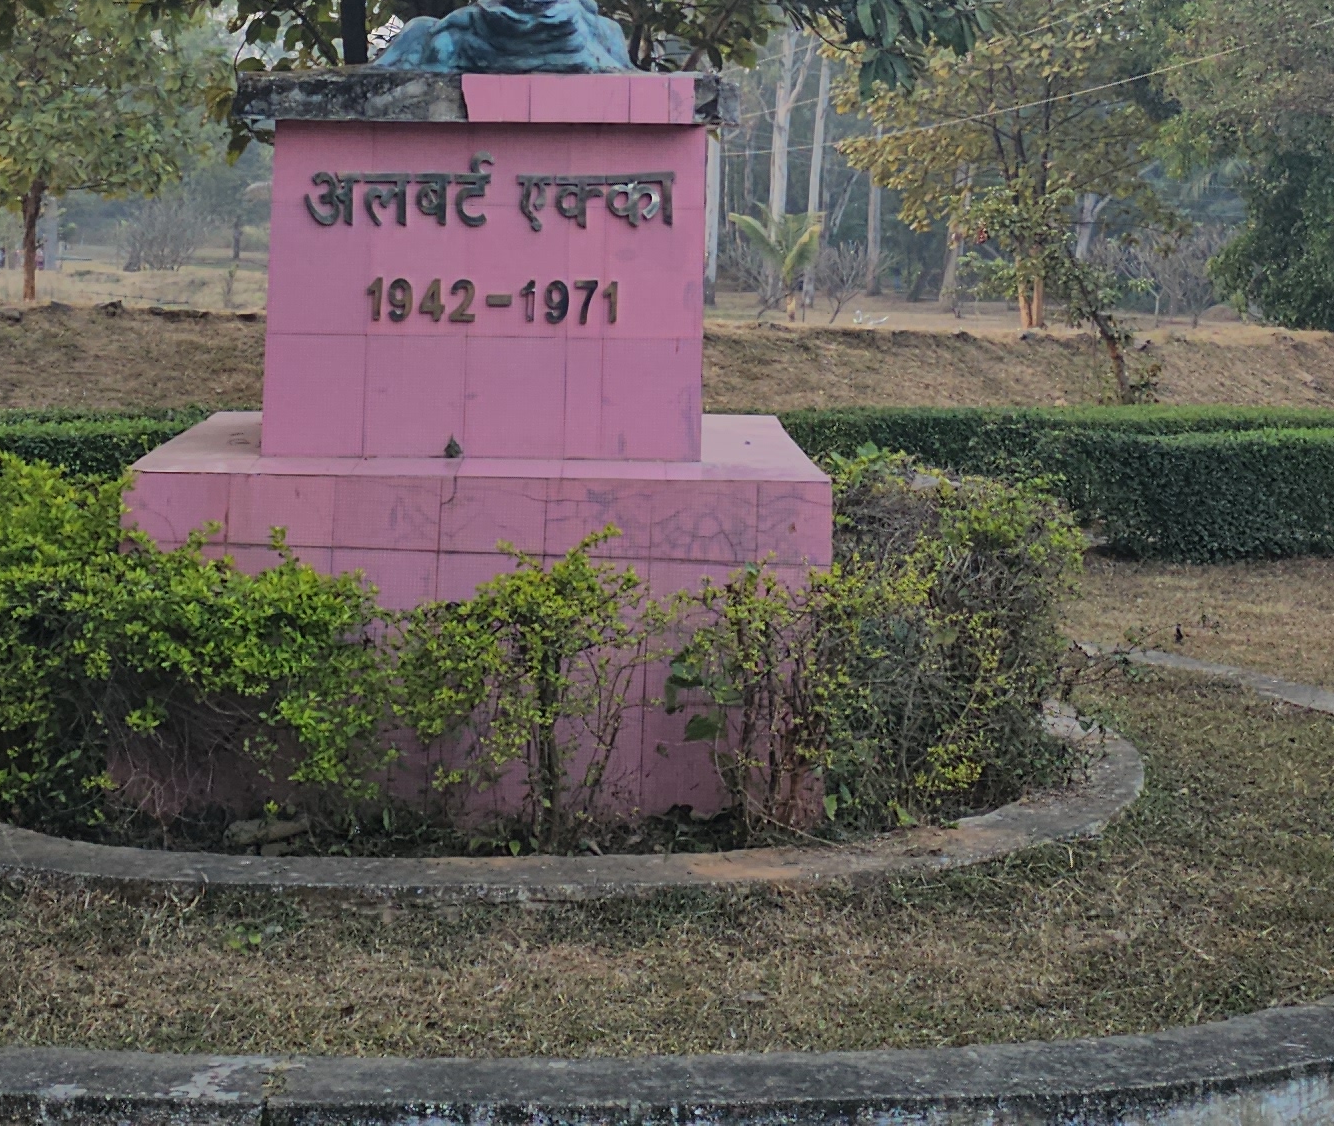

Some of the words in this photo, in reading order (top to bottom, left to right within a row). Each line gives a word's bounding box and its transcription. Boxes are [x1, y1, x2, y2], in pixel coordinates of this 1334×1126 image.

[304, 150, 495, 228] अलबर्ट
[517, 171, 675, 232] एक्का
[366, 277, 619, 325] 1942-1971
